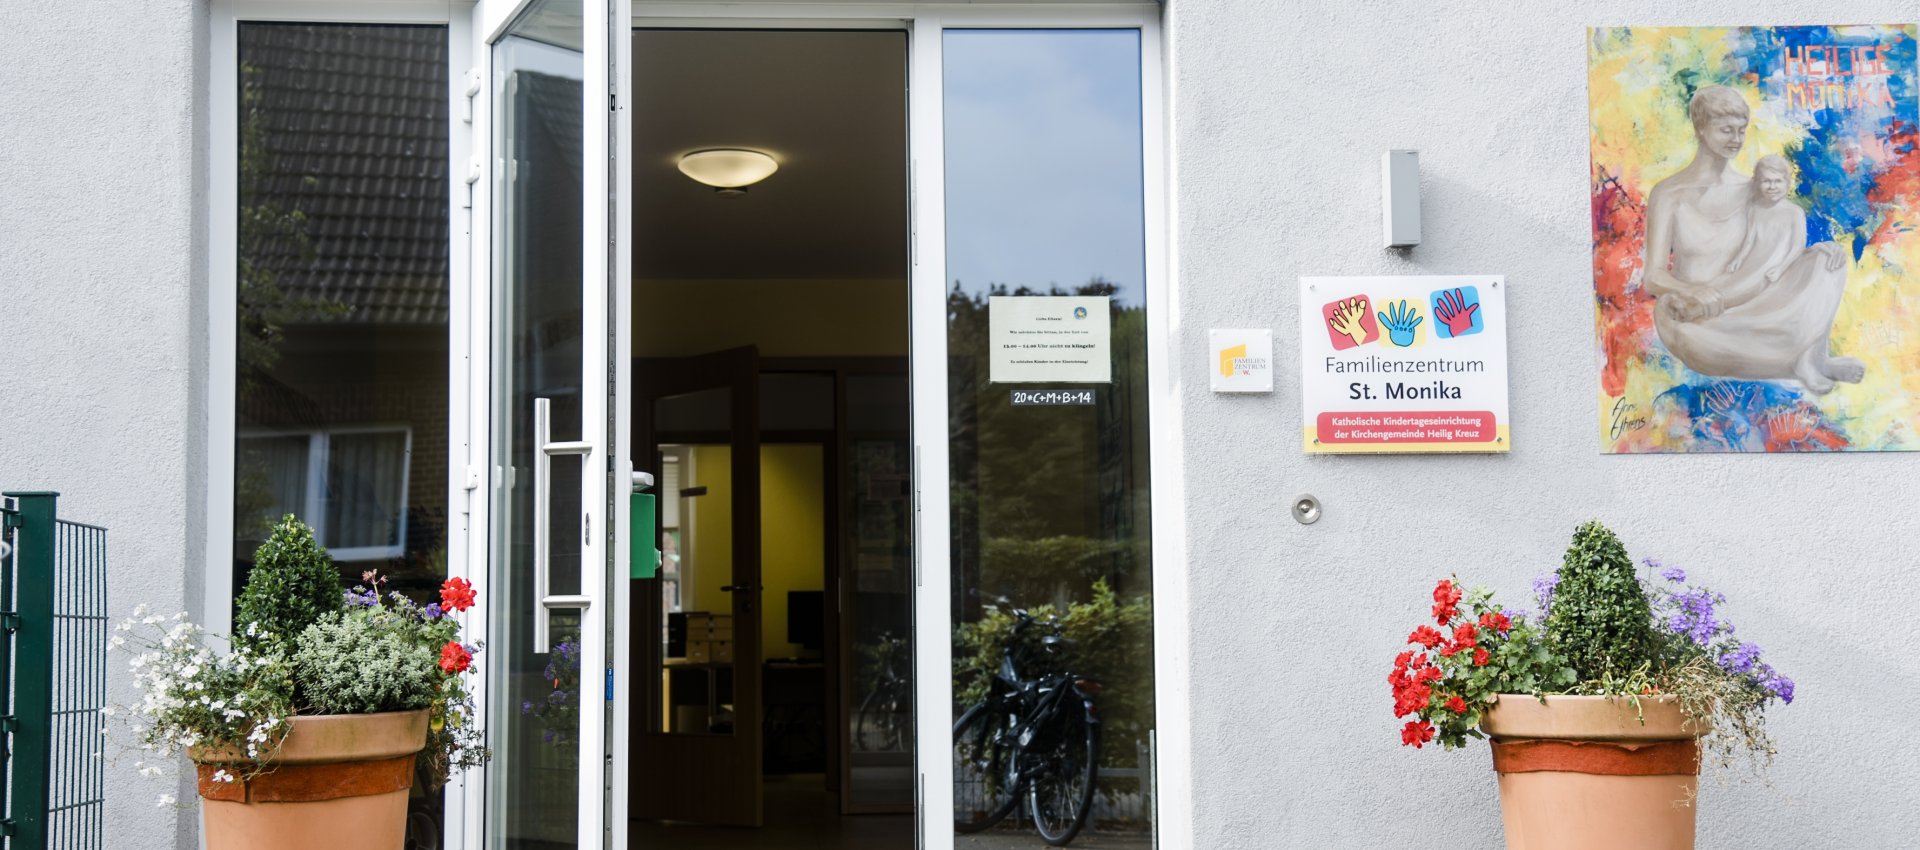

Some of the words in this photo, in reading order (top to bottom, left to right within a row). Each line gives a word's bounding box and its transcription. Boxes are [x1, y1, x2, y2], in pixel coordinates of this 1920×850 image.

[1785, 44, 1895, 76] HEILIGE
[1326, 355, 1484, 373] Familienzentrum
[1349, 382, 1377, 400] St.
[1385, 380, 1462, 400] Monika
[1331, 416, 1381, 426] Katholische
[1383, 416, 1481, 428] Kindertageseinrichtung
[1334, 430, 1349, 439] der
[1351, 429, 1425, 441] Kirchengemeinde
[1427, 429, 1453, 440] Heilig
[1455, 429, 1480, 438] Kreuz
